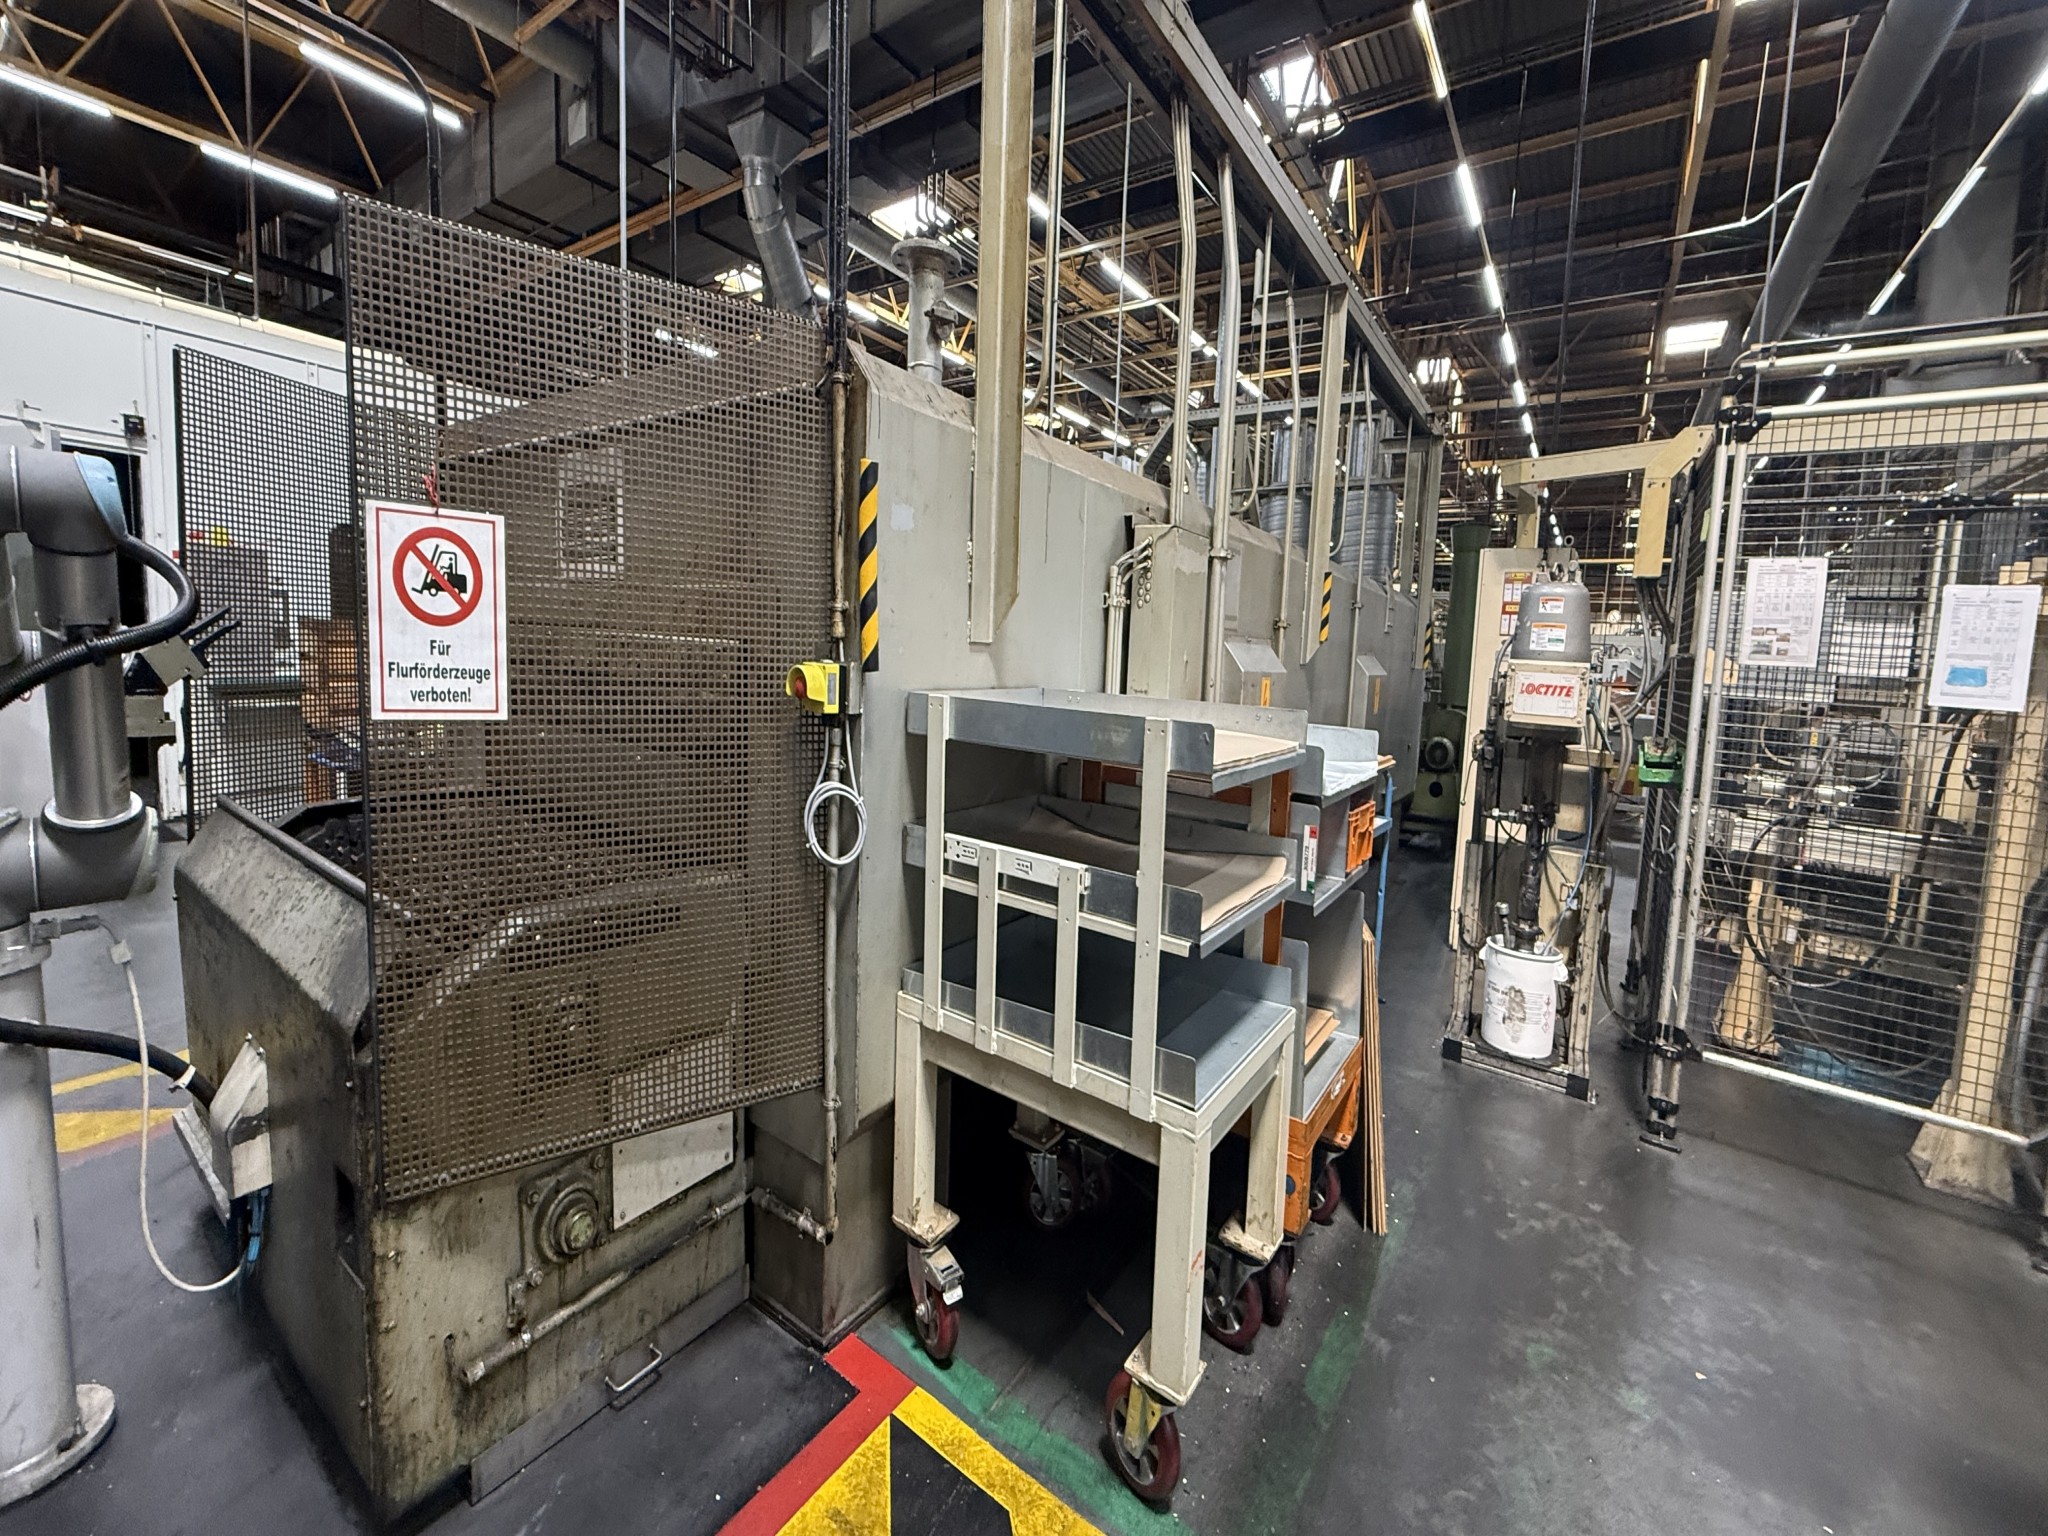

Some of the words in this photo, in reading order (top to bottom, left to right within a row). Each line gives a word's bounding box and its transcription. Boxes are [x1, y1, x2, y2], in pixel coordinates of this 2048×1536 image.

[430, 640, 451, 656] Für
[388, 662, 491, 684] Flurförderzeuge
[410, 686, 471, 702] verboten!
[1519, 683, 1574, 697] LOCTITE
